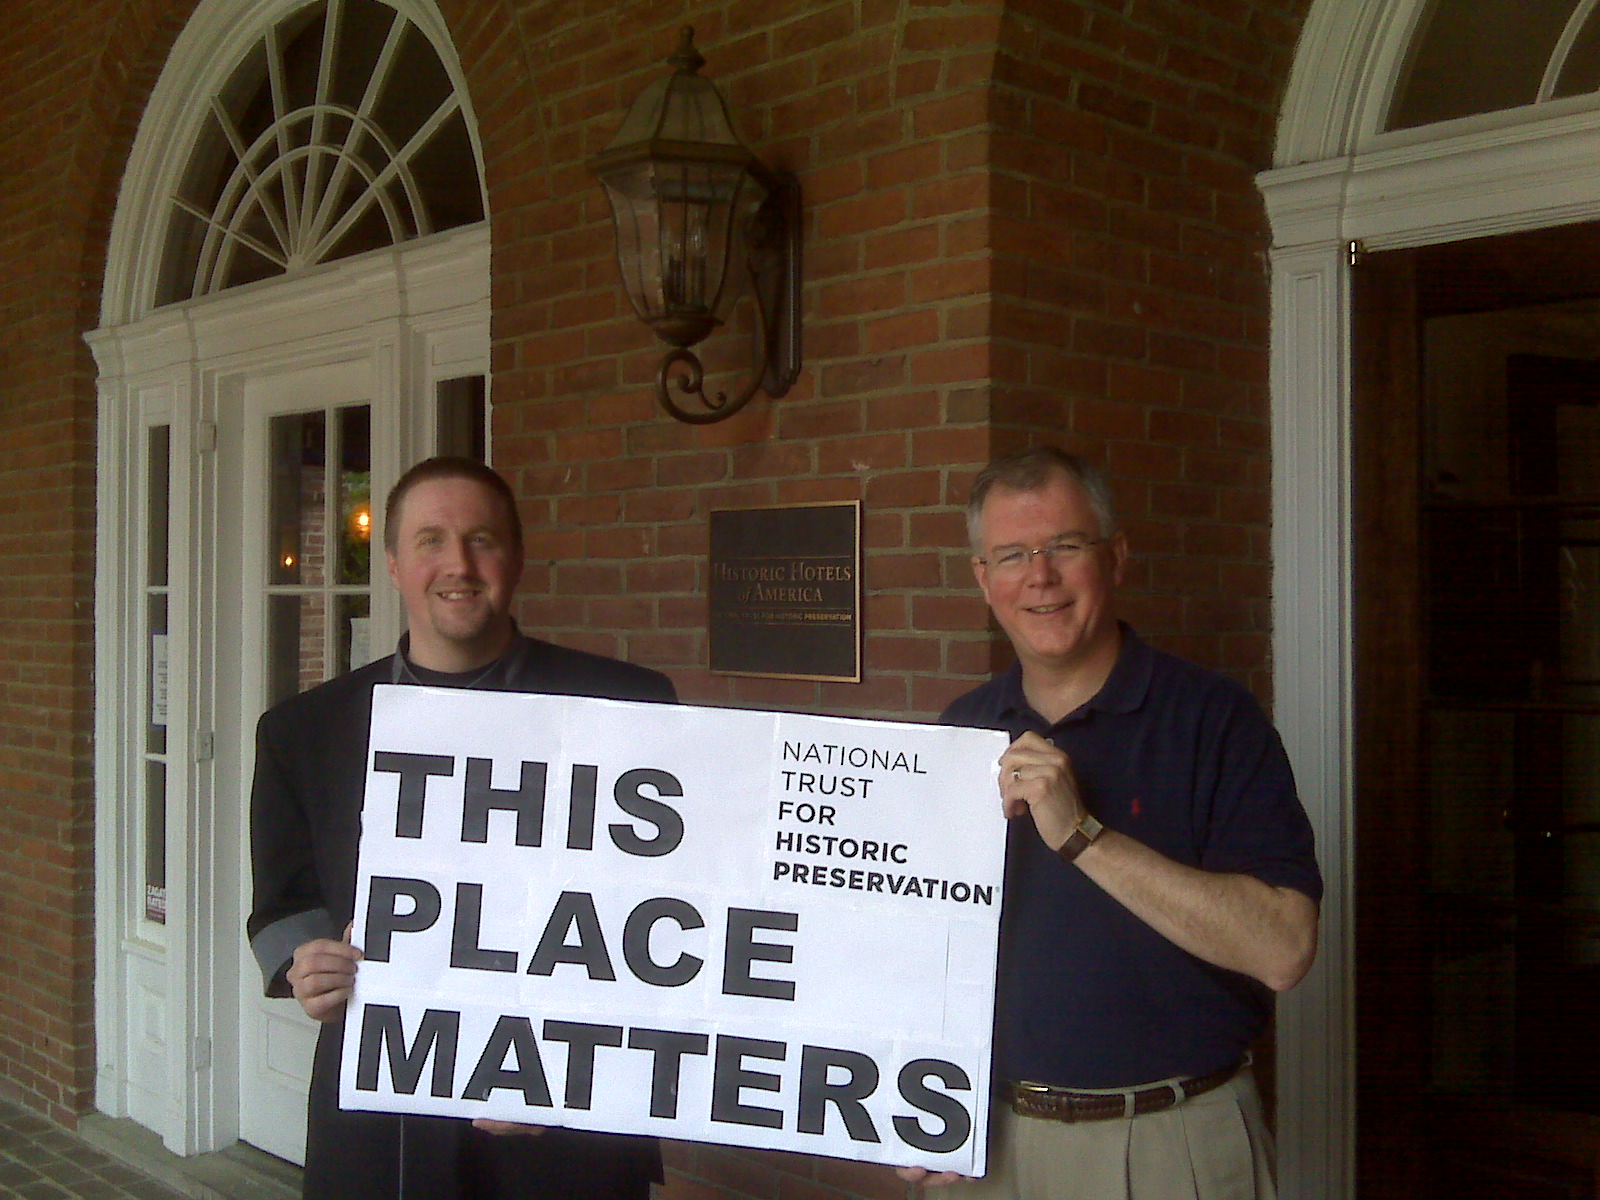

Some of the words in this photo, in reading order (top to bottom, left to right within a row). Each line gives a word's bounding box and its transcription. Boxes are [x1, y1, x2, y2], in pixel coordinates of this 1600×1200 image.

[714, 563, 785, 582] HISTORIC
[791, 562, 852, 582] HOTELS
[739, 587, 751, 604] of
[754, 583, 824, 602] AMERICA
[783, 741, 927, 775] NATIONAL
[781, 770, 874, 799] TRUST
[373, 750, 685, 858] THIS
[778, 800, 836, 826] FOR
[776, 831, 908, 864] HISTORIC
[773, 861, 993, 906] PRESERVATION
[363, 875, 799, 1002] PLACE
[355, 1003, 972, 1154] MATTERS
